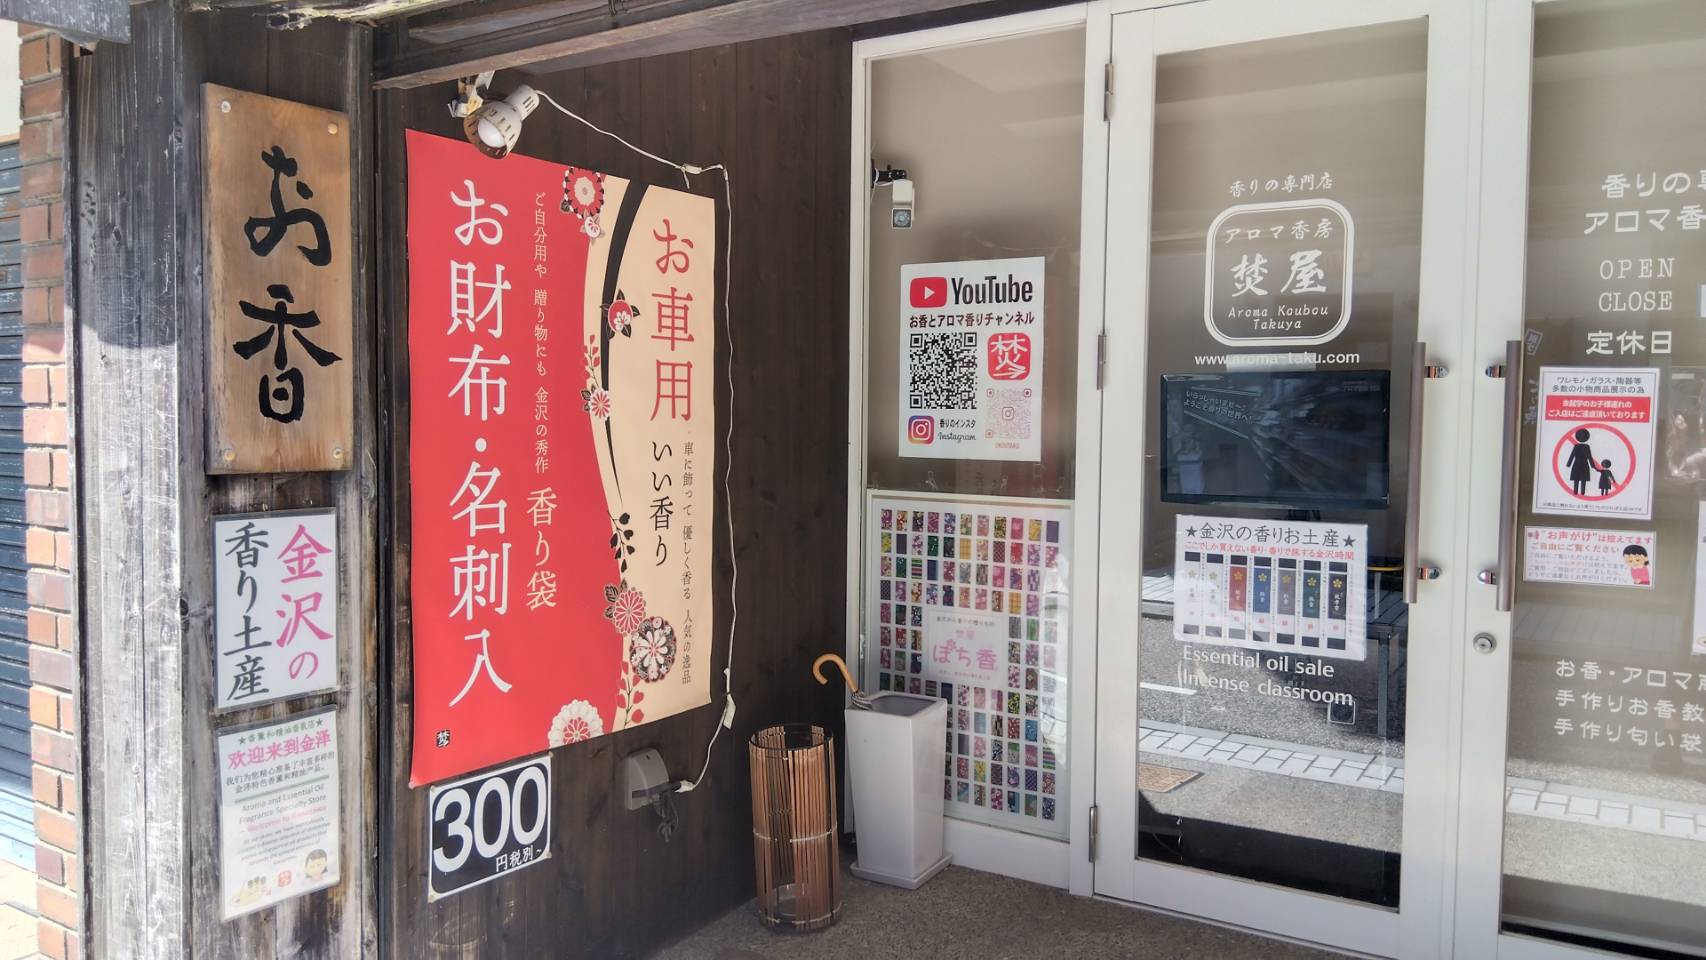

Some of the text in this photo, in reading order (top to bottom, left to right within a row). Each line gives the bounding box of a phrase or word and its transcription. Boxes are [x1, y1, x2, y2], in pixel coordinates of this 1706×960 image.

[1229, 171, 1333, 198] 香りの専門店
[1225, 218, 1334, 244] アロマ香房
[1584, 204, 1706, 234] アロマ香
[233, 145, 342, 424] お香
[1230, 250, 1327, 297] 焚屋
[1600, 258, 1675, 279] OPEN
[952, 274, 1032, 305] YouTube
[1599, 291, 1672, 312] CLOSE
[910, 312, 1034, 328] お香とアロマ香りチャンネル
[1228, 304, 1328, 318] Aroma Koubou
[1254, 318, 1301, 331] Takuya
[1195, 352, 1360, 365] www.aroma-taku.com
[1586, 330, 1672, 355] 定休日
[526, 192, 557, 611] ご自分用や 贈り物にも 金沢の秀作 香り袋
[649, 219, 694, 567] お車用 いい香り
[939, 418, 976, 428] 香りのインスタ
[939, 431, 976, 443] Instagram
[447, 179, 512, 707] お財布・名刺入
[681, 441, 694, 516] 車に飾って
[681, 525, 693, 600] 優しく香る
[223, 522, 272, 701] 香り土産
[276, 524, 334, 680] 金沢の
[1183, 645, 1334, 678] Essential oil sale
[1183, 668, 1353, 706] Inense classroom
[1555, 689, 1705, 723] 手作りお香教
[228, 729, 331, 769] 欢迎来到金泽
[1554, 718, 1703, 752] 手作り匂い袋
[433, 766, 547, 873] 300
